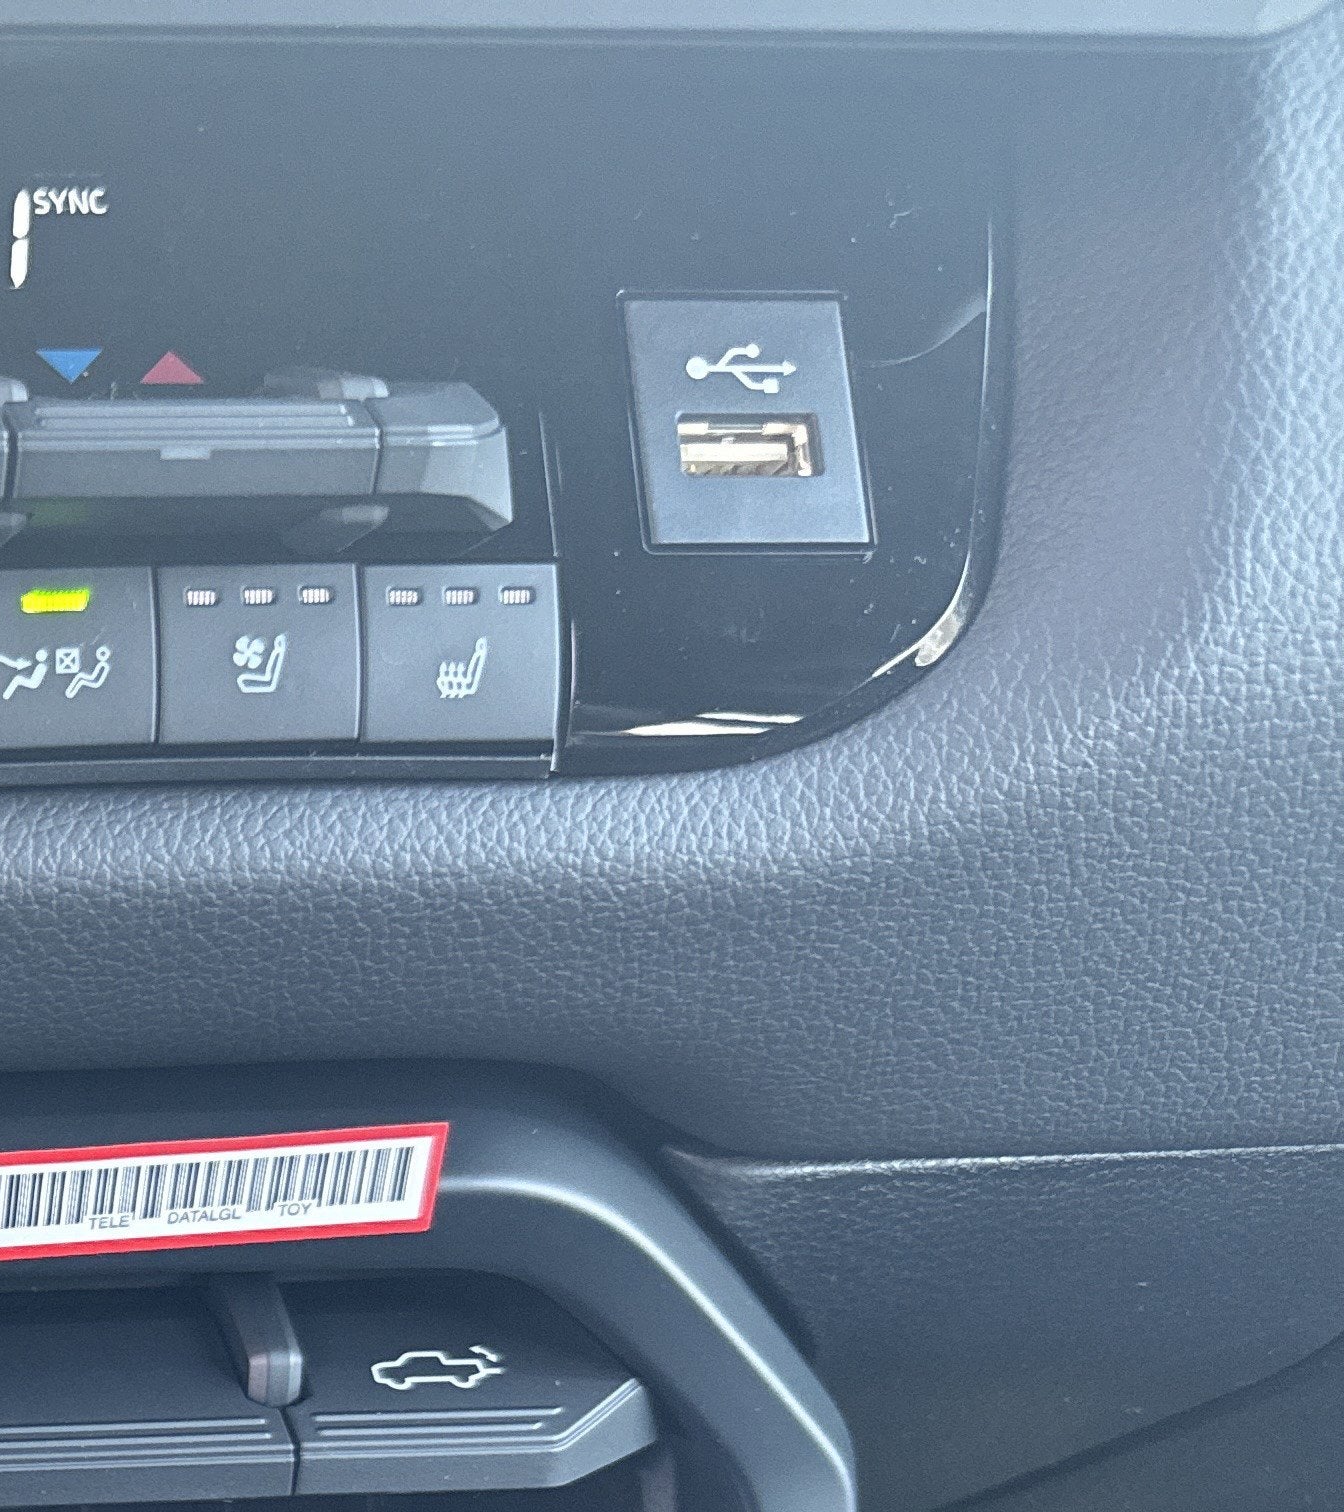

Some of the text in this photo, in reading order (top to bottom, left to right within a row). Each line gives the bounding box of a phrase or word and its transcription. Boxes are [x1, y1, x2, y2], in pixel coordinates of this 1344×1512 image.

[33, 188, 108, 216] SYNC
[88, 1202, 312, 1230] TELE DATALGL TOY
